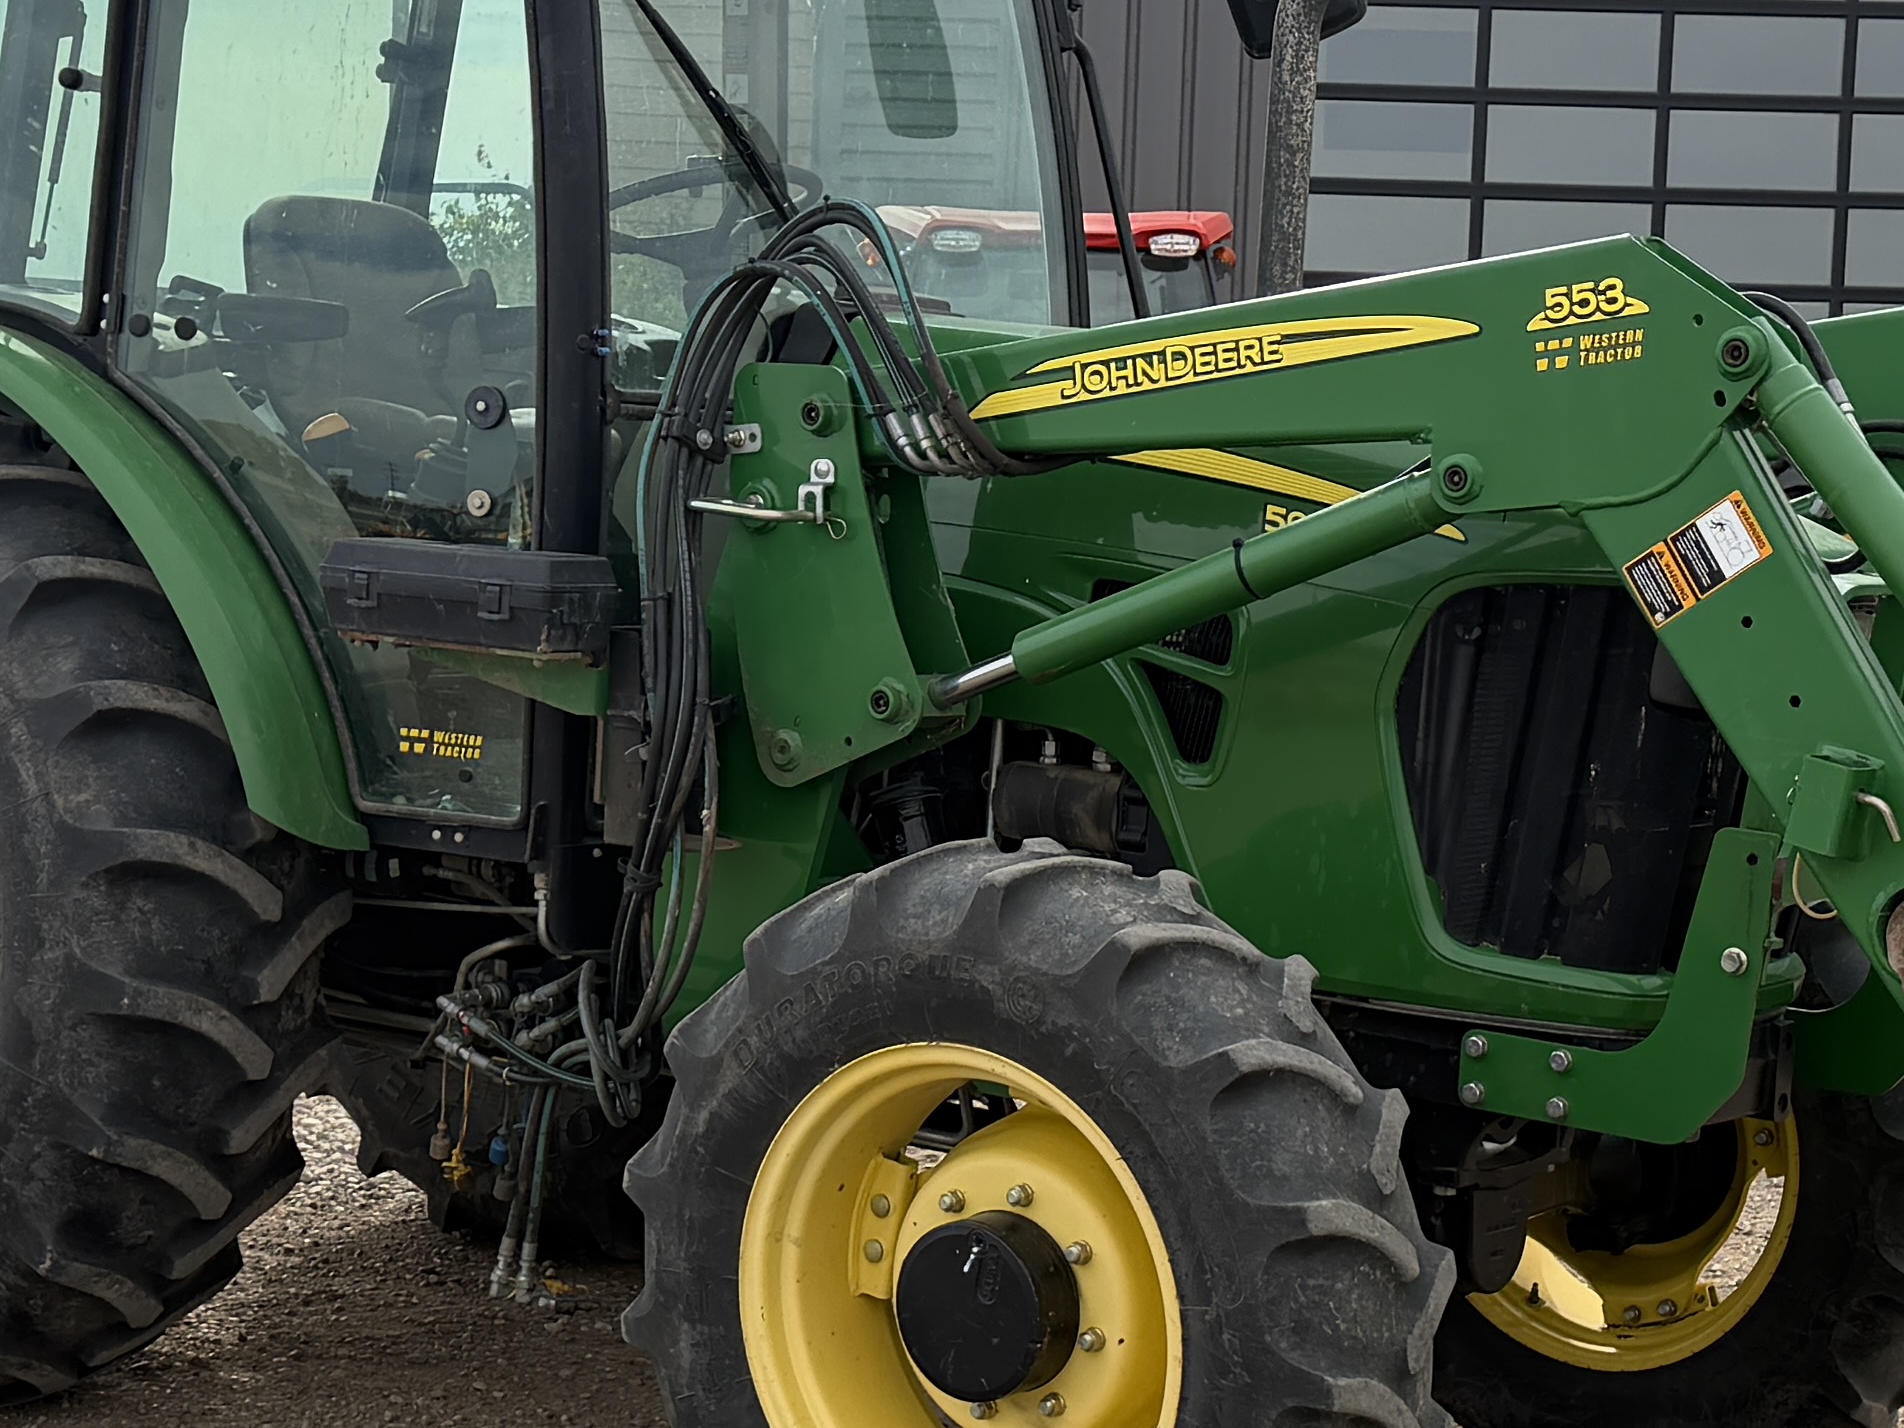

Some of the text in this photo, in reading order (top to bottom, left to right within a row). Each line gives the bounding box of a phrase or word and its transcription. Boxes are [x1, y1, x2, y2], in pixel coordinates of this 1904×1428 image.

[1544, 276, 1627, 322] 553
[1578, 328, 1645, 351] WESTERN
[1060, 333, 1285, 400] JOHN DEERE
[1578, 345, 1643, 367] TRACTOR
[433, 730, 483, 746] WESTERN
[432, 744, 481, 759] TRACTOR
